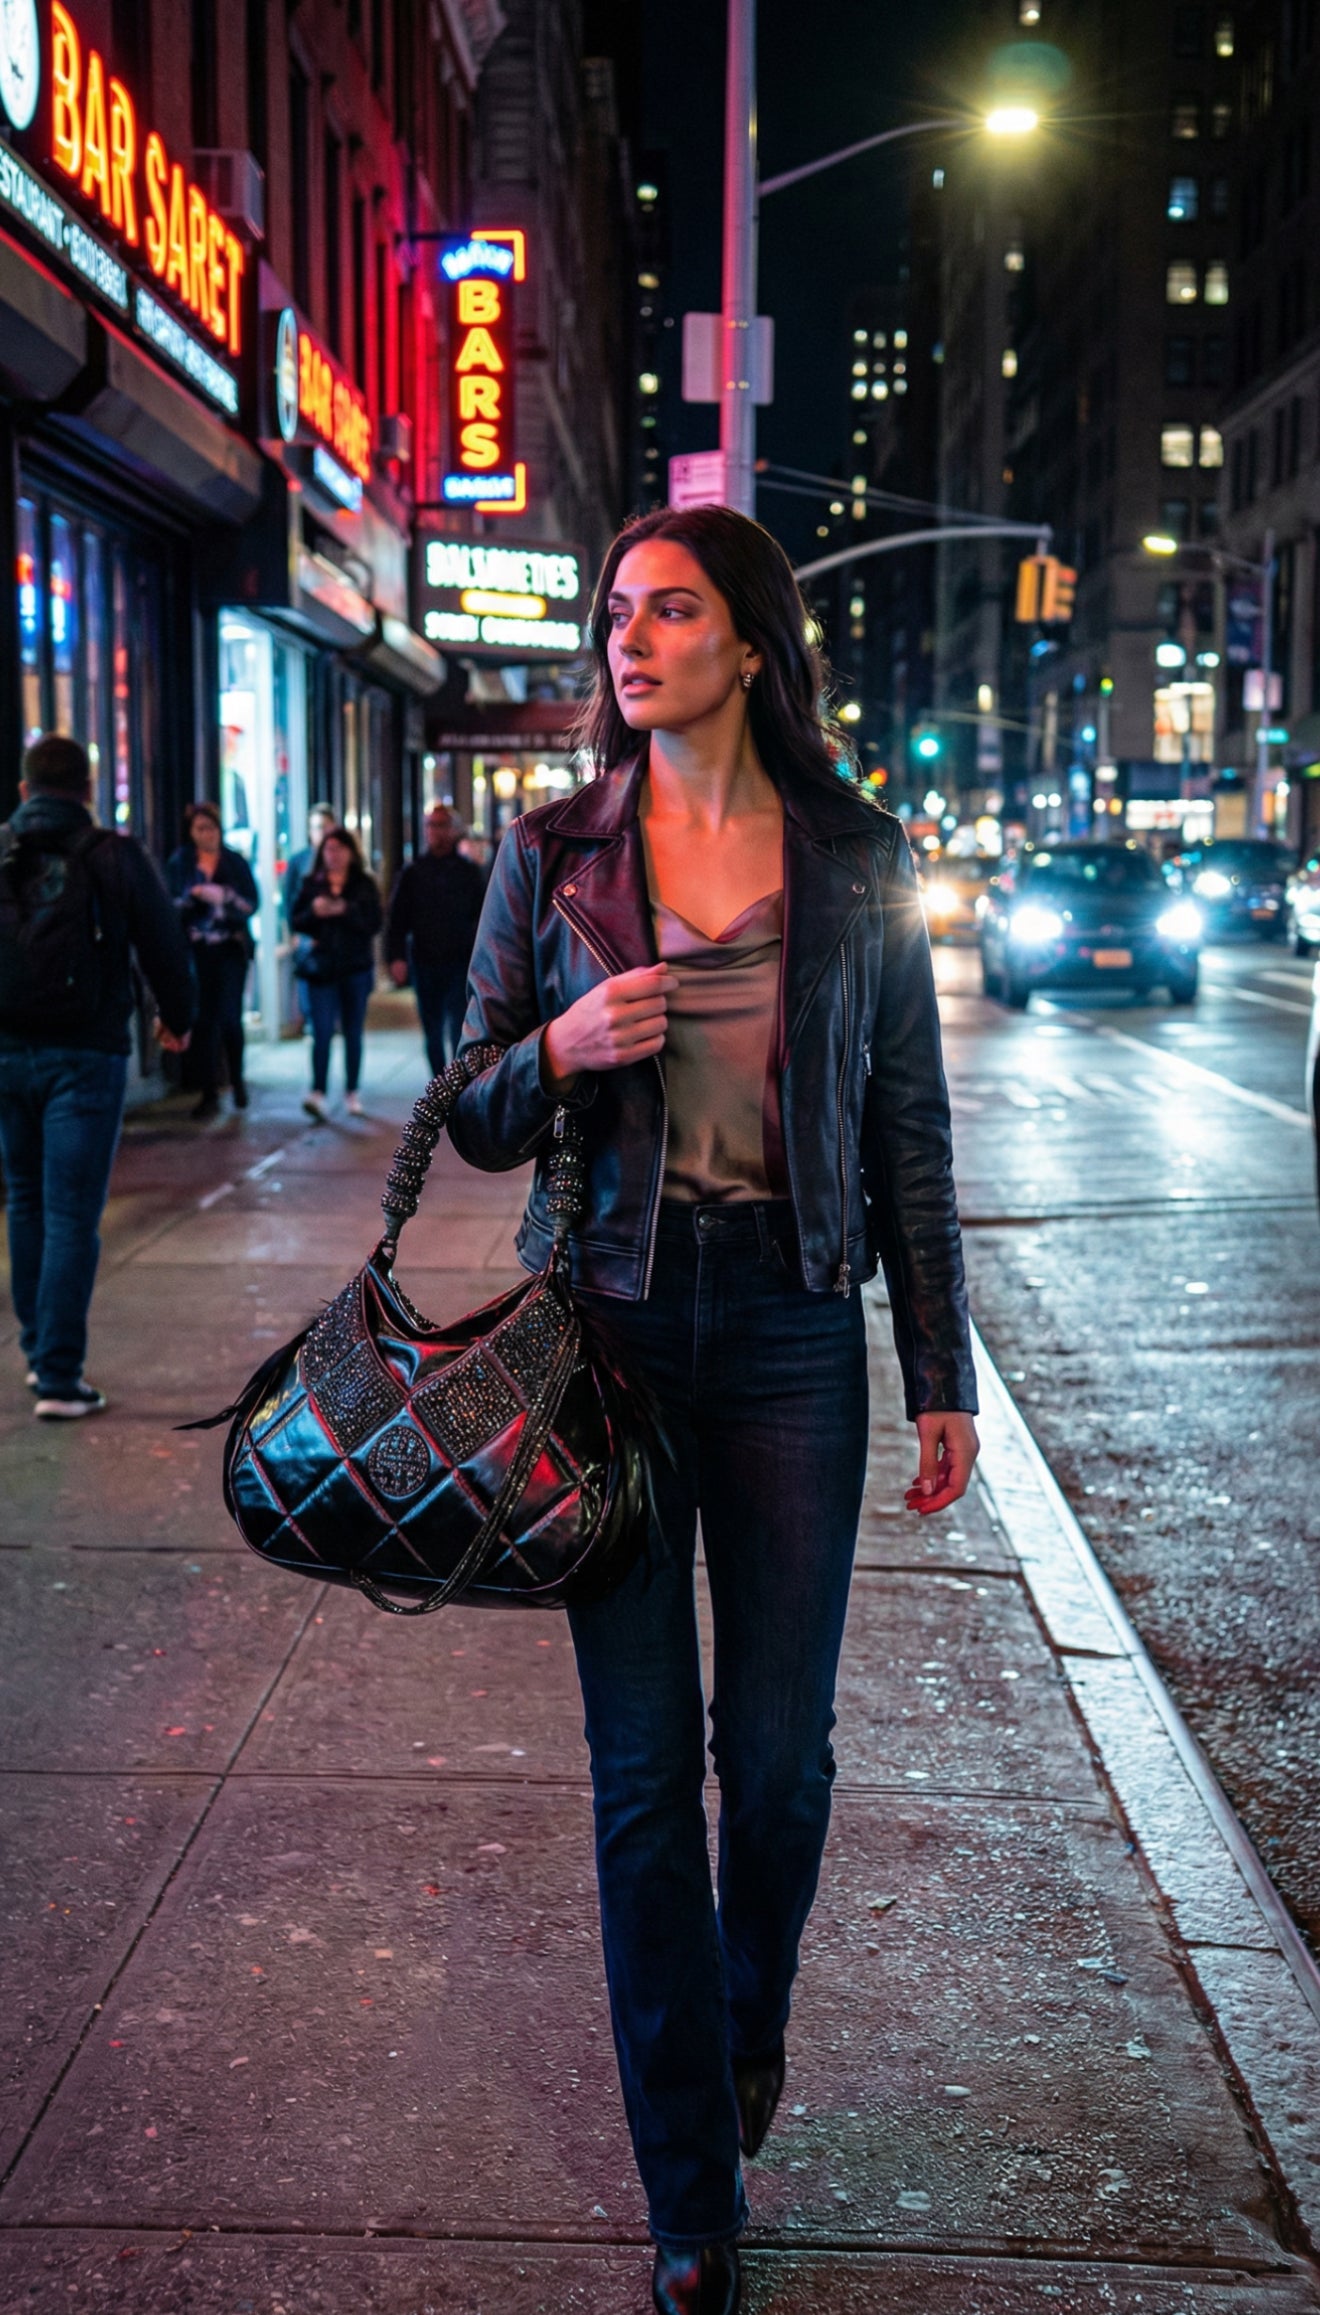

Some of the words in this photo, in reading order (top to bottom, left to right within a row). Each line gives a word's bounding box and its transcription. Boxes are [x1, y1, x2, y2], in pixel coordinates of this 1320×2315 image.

[52, 0, 138, 246] BAR
[146, 131, 243, 357] SARET
[455, 279, 504, 468] BARS
